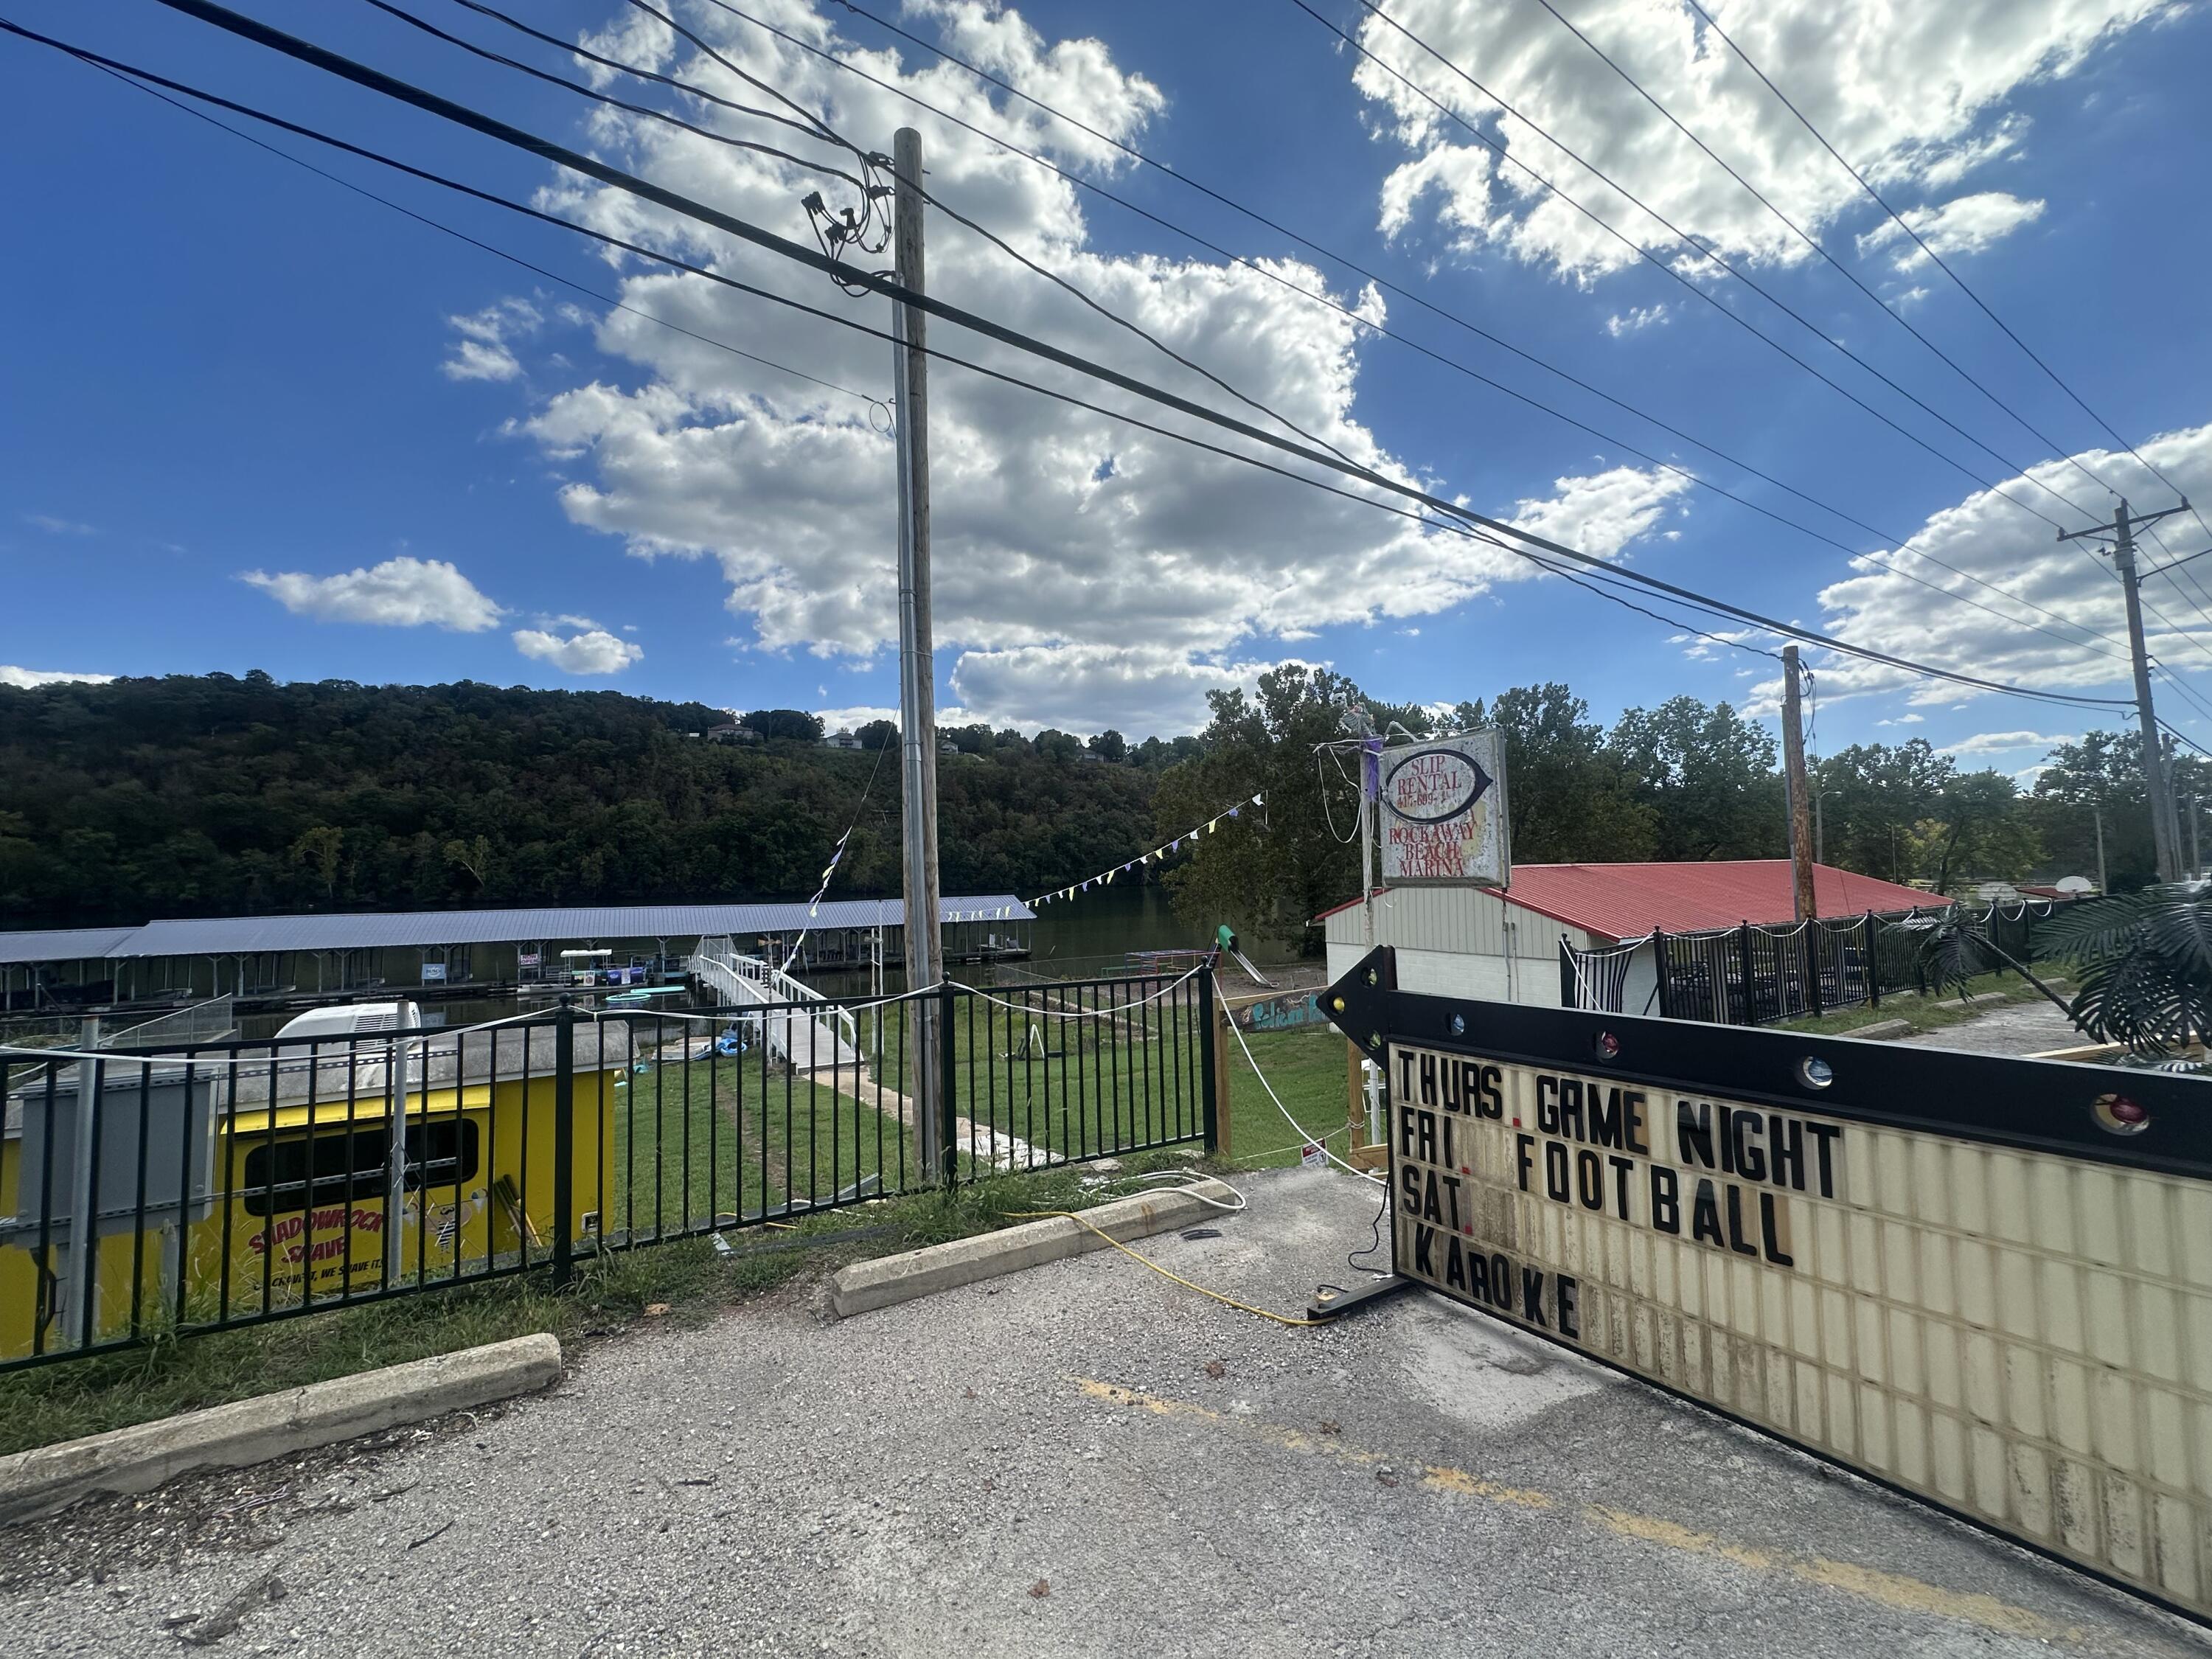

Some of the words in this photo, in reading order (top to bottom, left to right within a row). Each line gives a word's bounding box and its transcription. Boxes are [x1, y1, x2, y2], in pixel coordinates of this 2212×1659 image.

[1411, 755, 1445, 775] SLIP
[1398, 771, 1461, 796] RENTAL
[1389, 821, 1476, 844] ROCKAWAY
[1405, 841, 1460, 860] BEACH
[1400, 858, 1465, 877] MARINA
[1253, 1001, 1304, 1030] Pelican
[1537, 1075, 1649, 1155] GAME
[1677, 1101, 1840, 1199] NIGHT
[1517, 1133, 1793, 1267] FOOTBALL
[281, 1237, 346, 1263] SAVE
[321, 1267, 335, 1279] WE
[1415, 1223, 1579, 1339] KAROKE
